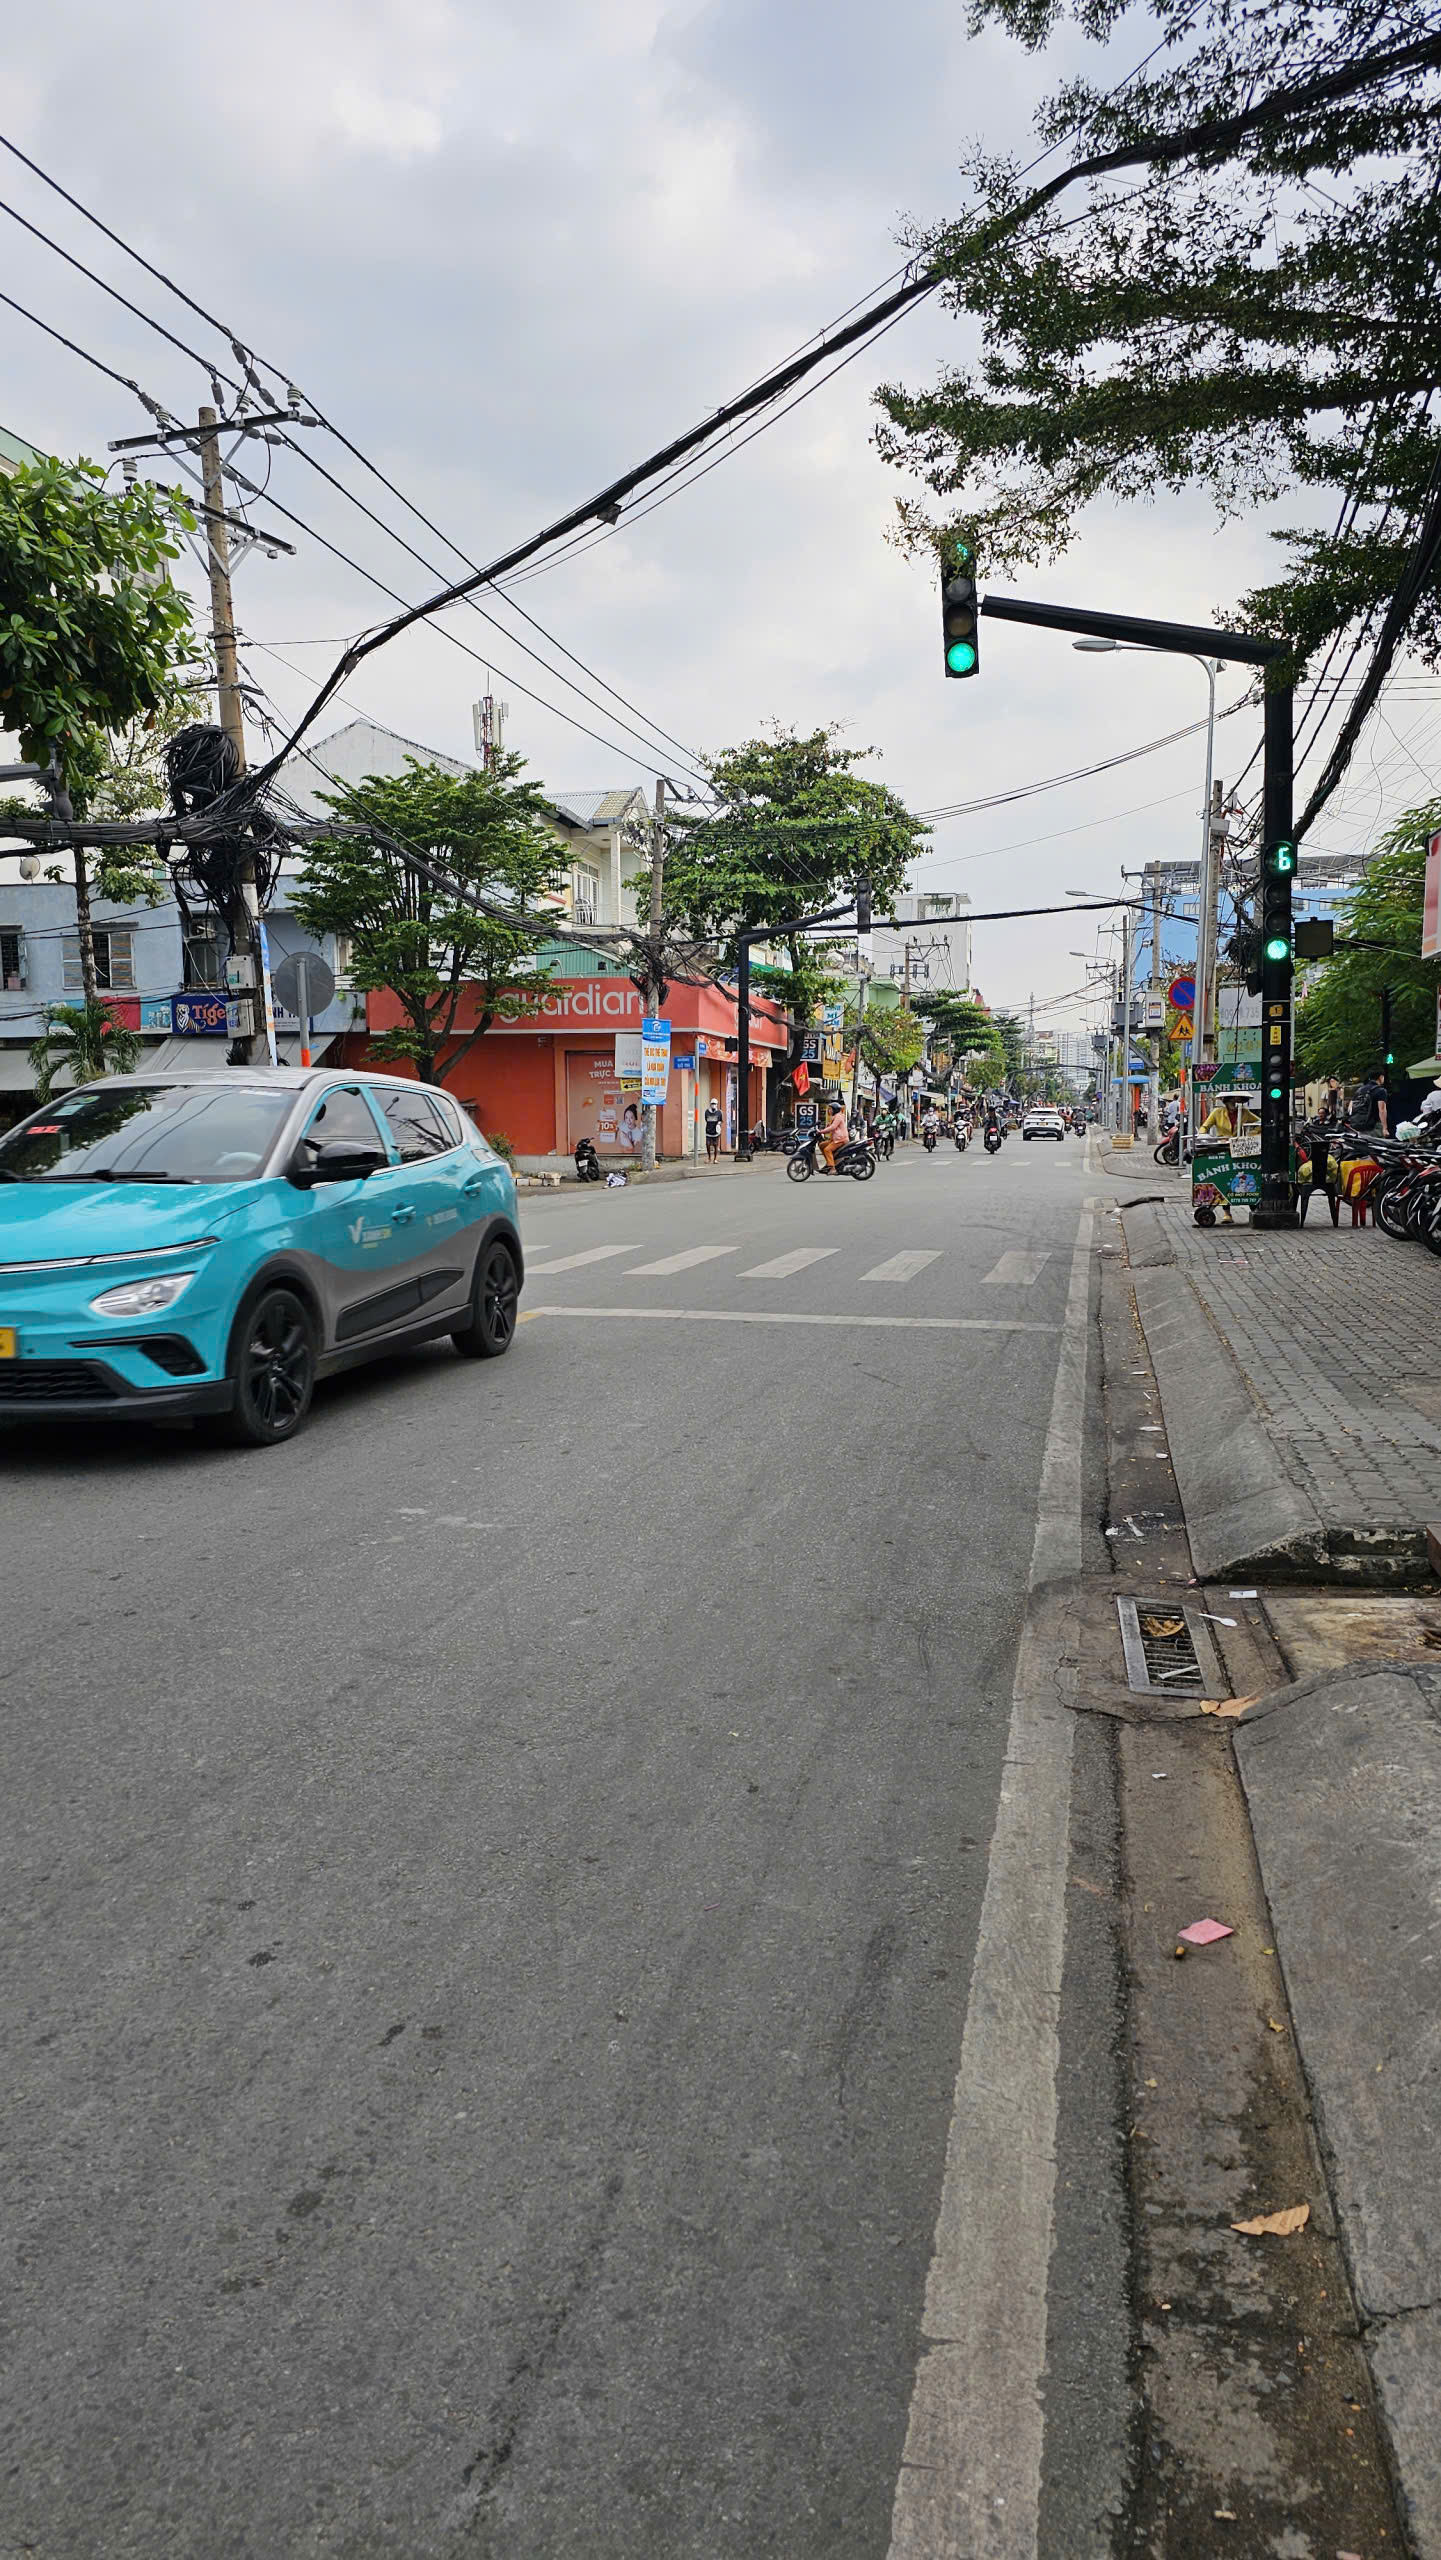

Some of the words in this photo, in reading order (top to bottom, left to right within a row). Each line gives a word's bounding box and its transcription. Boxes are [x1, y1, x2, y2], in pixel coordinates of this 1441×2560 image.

[1278, 847, 1291, 871] 6
[192, 1001, 226, 1027] Tige
[801, 1049, 816, 1059] 25
[594, 1060, 613, 1068] MUA
[589, 1069, 611, 1079] TRỰC
[1200, 1082, 1230, 1092] BÁNH
[799, 1106, 814, 1116] GS
[800, 1116, 813, 1126] 25
[1197, 1163, 1230, 1182] BÁNH
